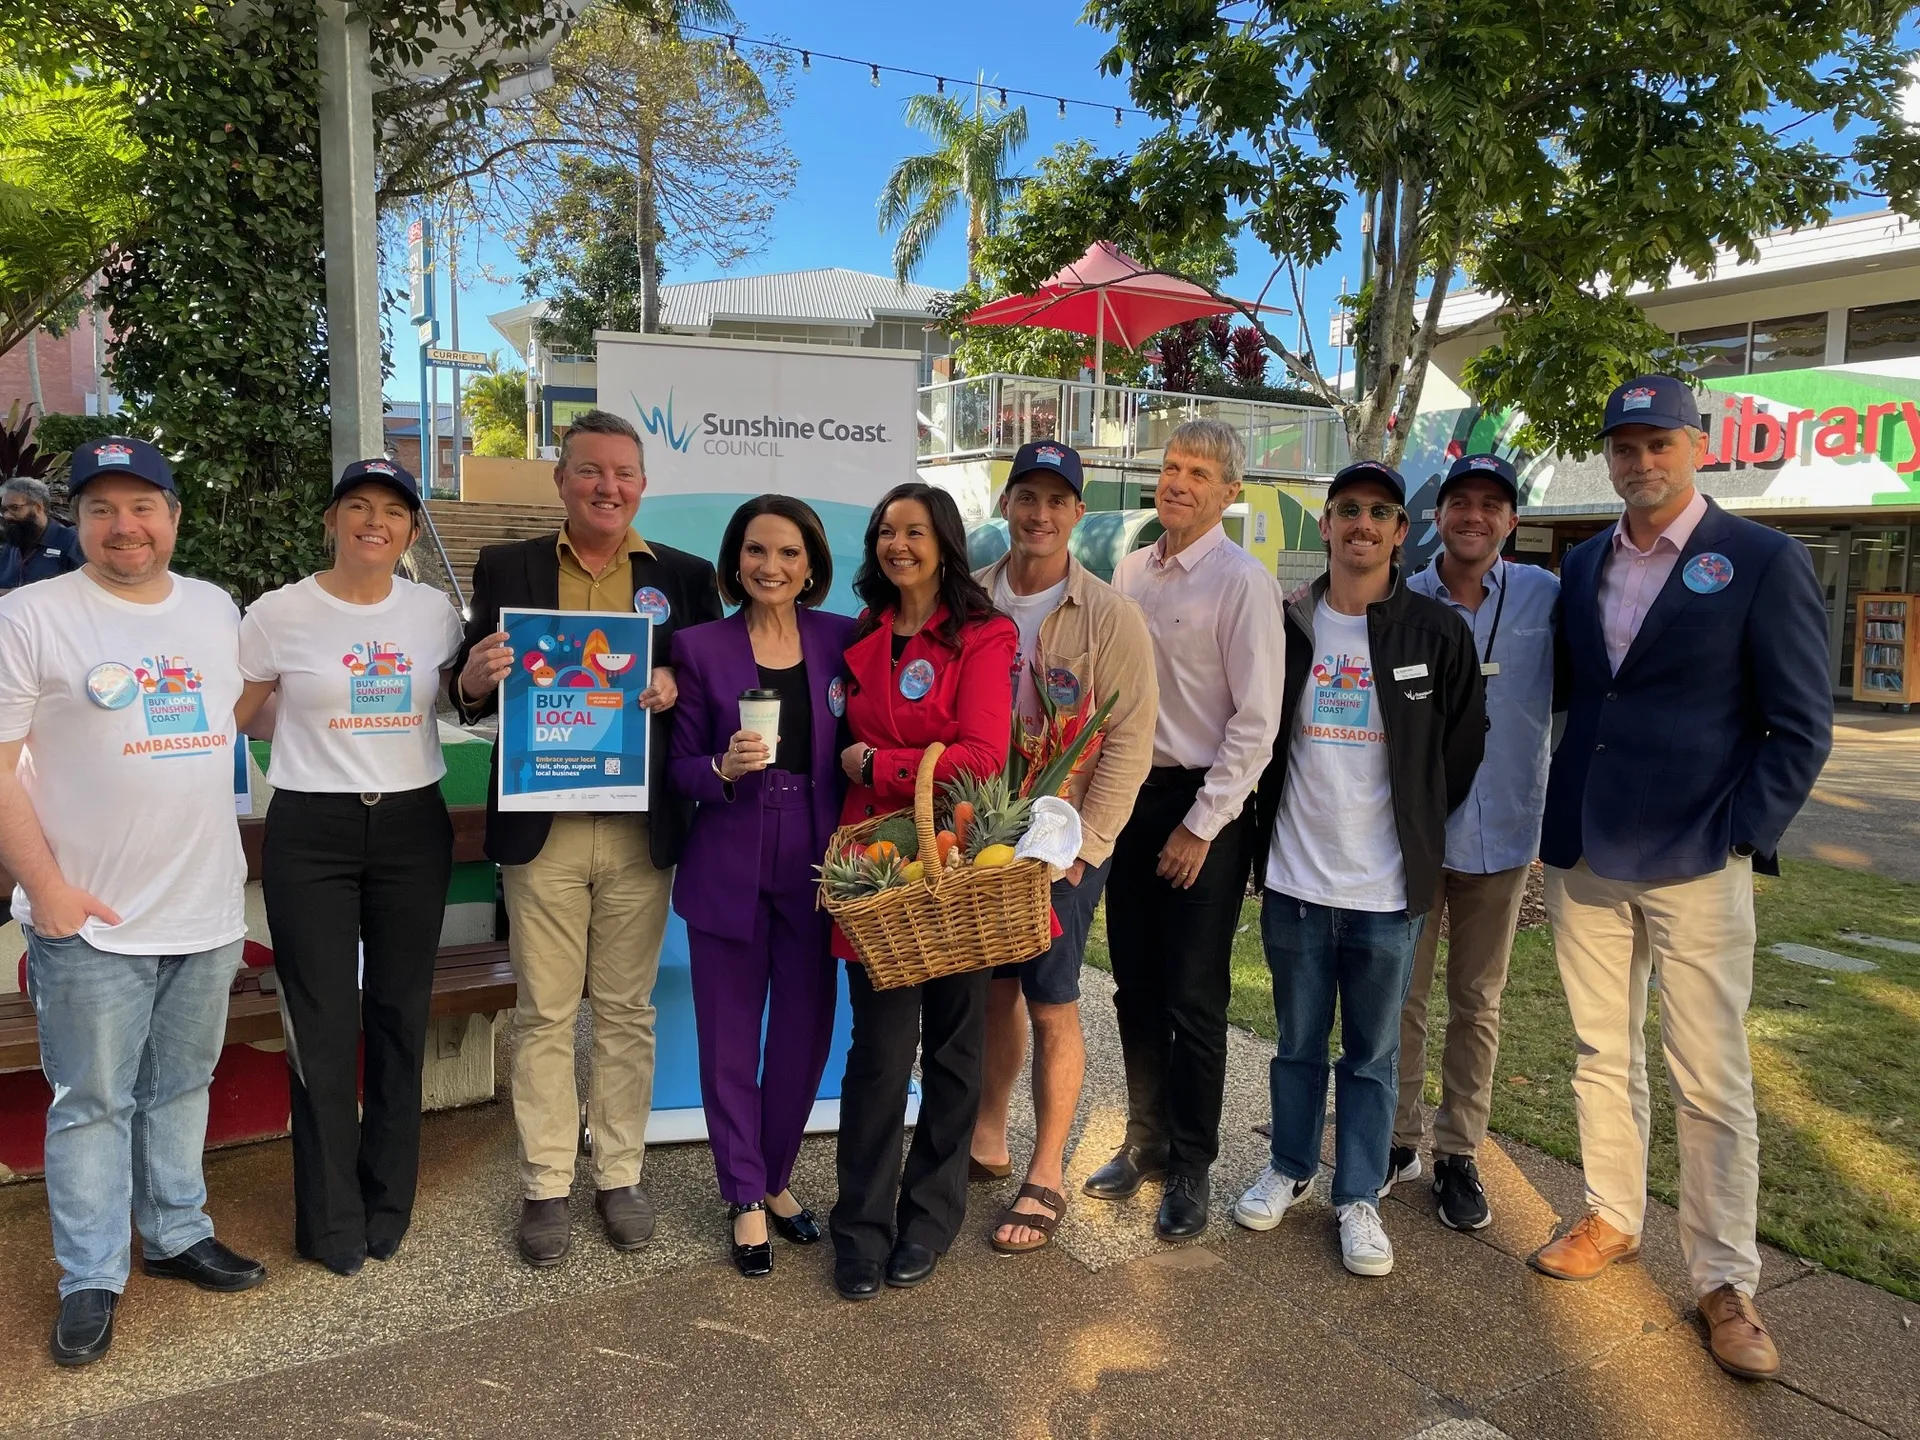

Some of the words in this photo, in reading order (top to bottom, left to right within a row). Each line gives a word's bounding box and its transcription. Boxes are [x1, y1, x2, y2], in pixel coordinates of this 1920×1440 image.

[433, 351, 468, 361] CURRIE
[703, 413, 815, 439] Sunshine
[818, 418, 887, 443] Coast
[1703, 396, 1920, 474] ibrary
[703, 439, 784, 458] COUNCIL
[356, 680, 374, 688] BUY
[376, 679, 405, 687] LOCAL
[356, 687, 402, 695] SUNSHINE
[148, 698, 167, 706] BUY
[168, 696, 198, 705] LOCAL
[356, 695, 385, 703] COAST
[536, 694, 575, 708] BUY
[1338, 692, 1364, 701] LOCAL
[1318, 699, 1361, 708] SUNSHINE
[150, 705, 195, 715] SUNSHINE
[1317, 706, 1344, 714] COAST
[151, 714, 181, 723] COAST
[328, 714, 423, 729] AMBASSADOR
[536, 710, 596, 725] LOCAL
[536, 727, 573, 742] DAY
[122, 734, 228, 756] AMBASSADOR
